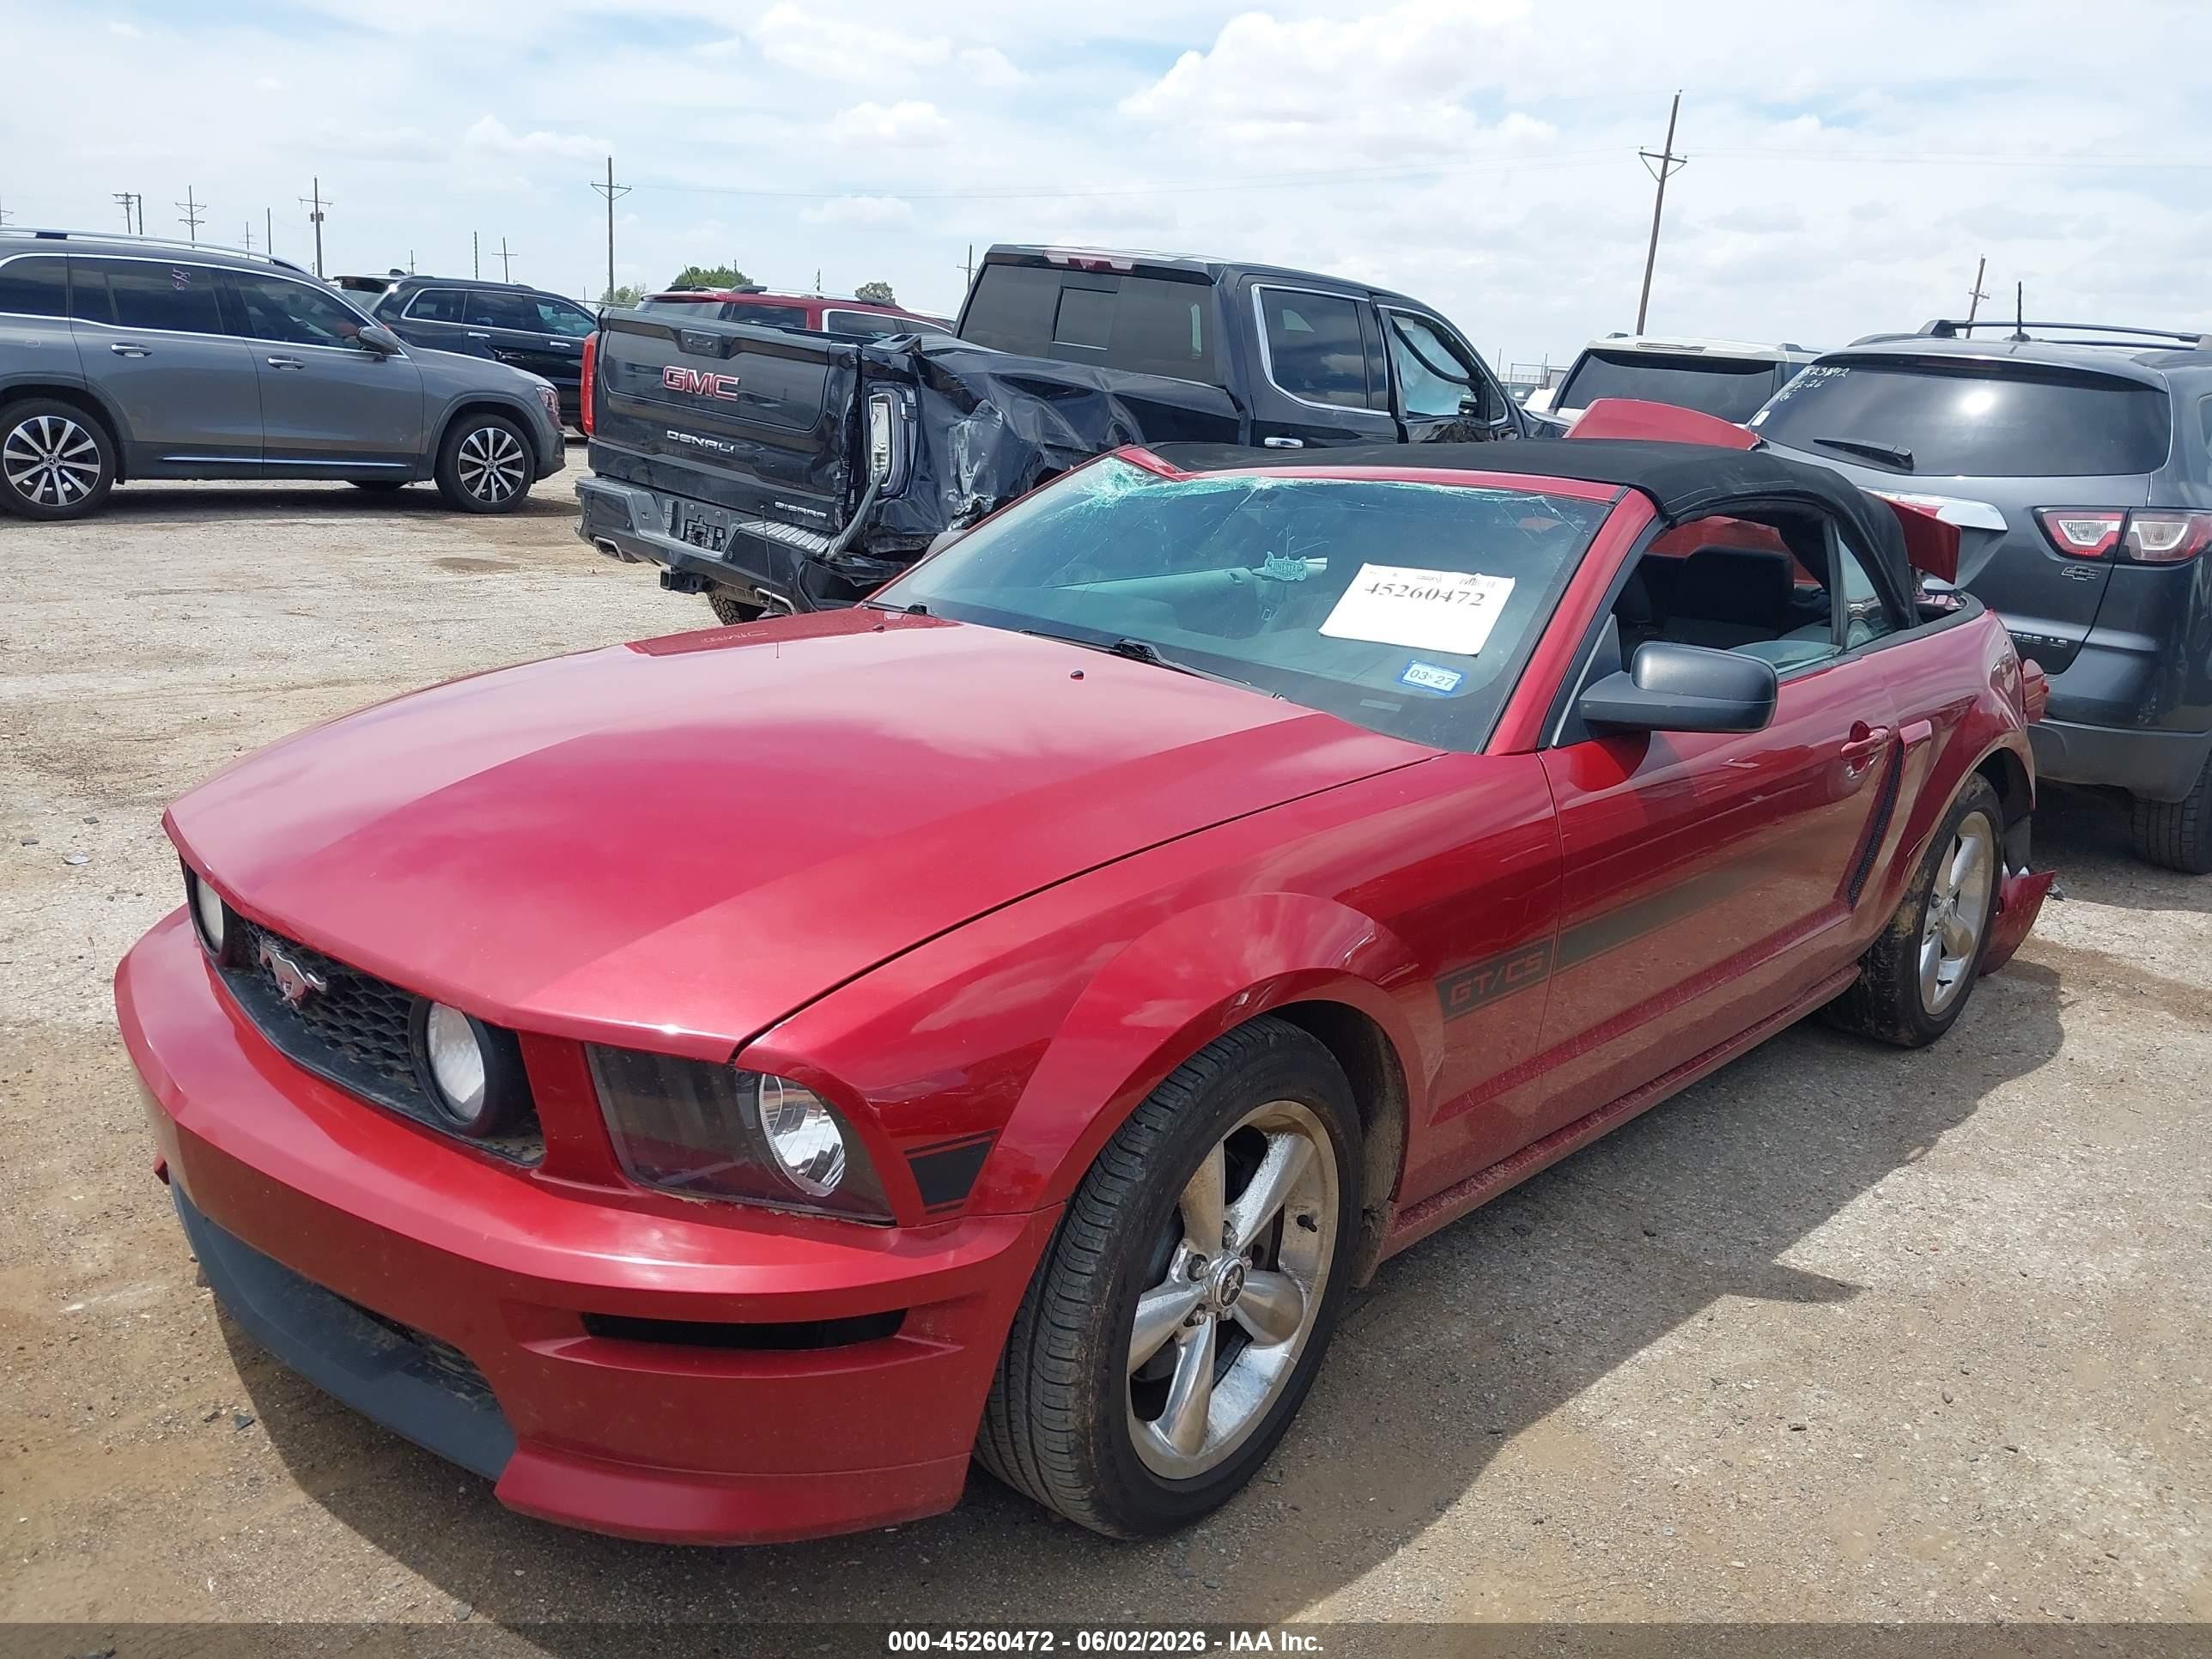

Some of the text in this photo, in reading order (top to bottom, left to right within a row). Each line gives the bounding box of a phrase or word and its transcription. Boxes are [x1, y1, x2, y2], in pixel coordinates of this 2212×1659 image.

[663, 365, 740, 402] GMC
[666, 429, 735, 454] DENALI
[775, 501, 828, 519] SIERRA
[1364, 582, 1486, 606] 45260472
[1450, 951, 1545, 1007] GT/CS
